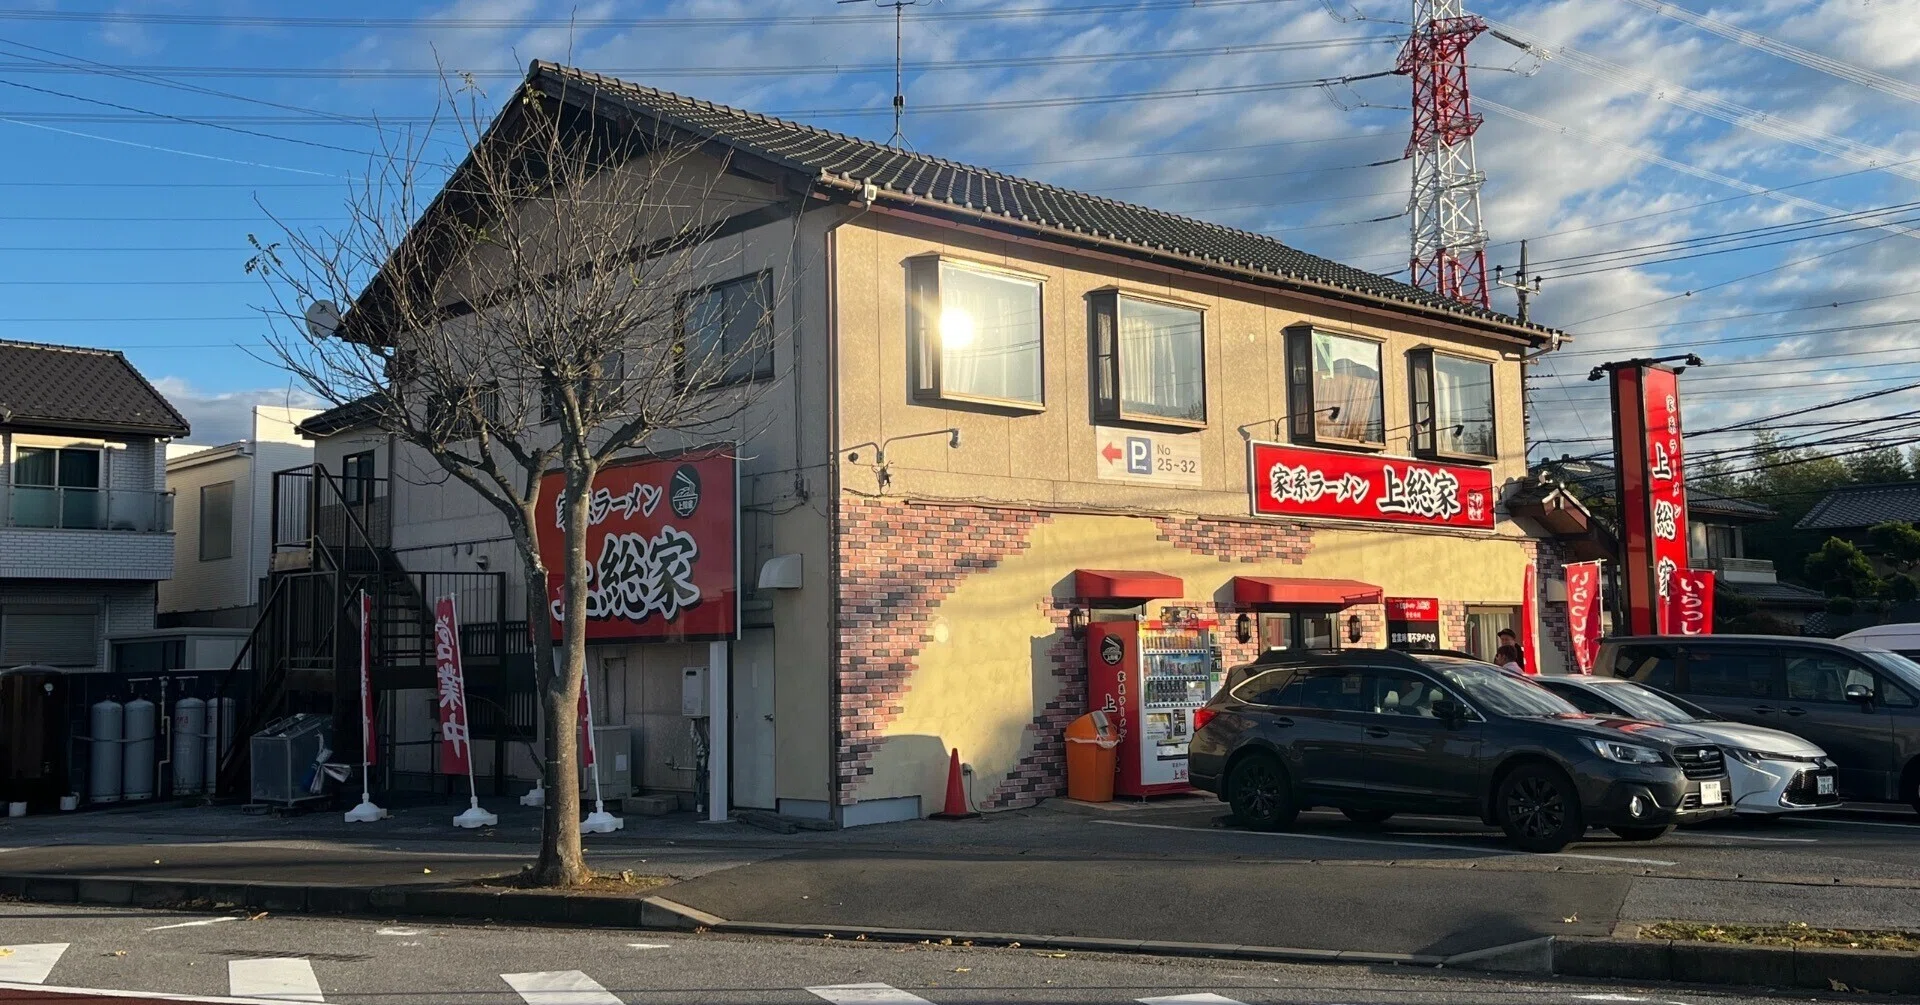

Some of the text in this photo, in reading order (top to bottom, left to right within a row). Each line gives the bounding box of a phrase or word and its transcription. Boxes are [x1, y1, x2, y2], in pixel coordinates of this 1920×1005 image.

[1157, 444, 1171, 456] No
[1666, 394, 1681, 518] 家系ラーメン
[556, 483, 663, 532] ラーメン
[1270, 463, 1370, 504] 家系ラーメン
[1376, 464, 1461, 520] 上総家
[551, 524, 701, 621] 総家
[1681, 577, 1705, 635] いらっし
